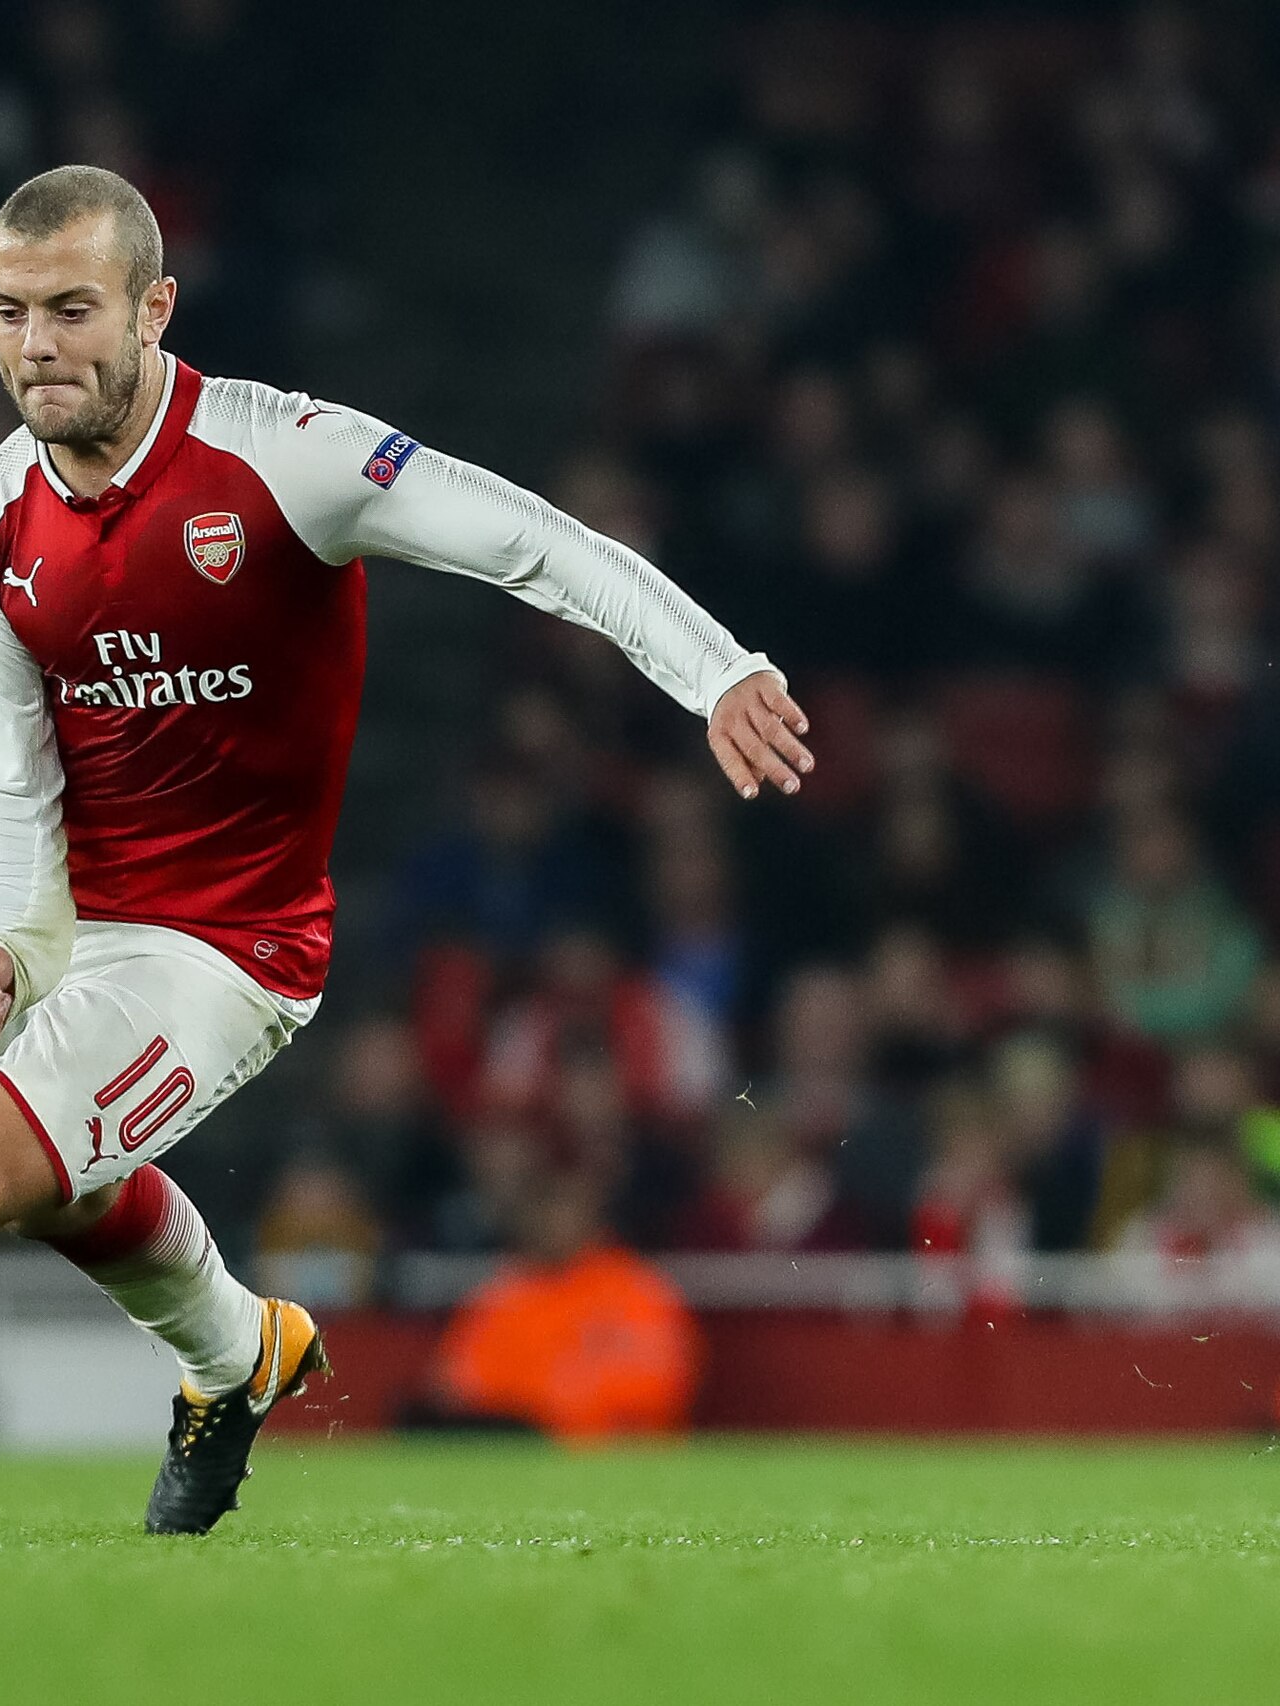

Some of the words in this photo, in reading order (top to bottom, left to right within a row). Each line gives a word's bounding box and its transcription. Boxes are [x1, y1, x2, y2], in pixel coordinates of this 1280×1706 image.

[192, 522, 234, 540] Arsenal
[93, 629, 161, 666] Fly
[94, 1034, 195, 1153] 10
